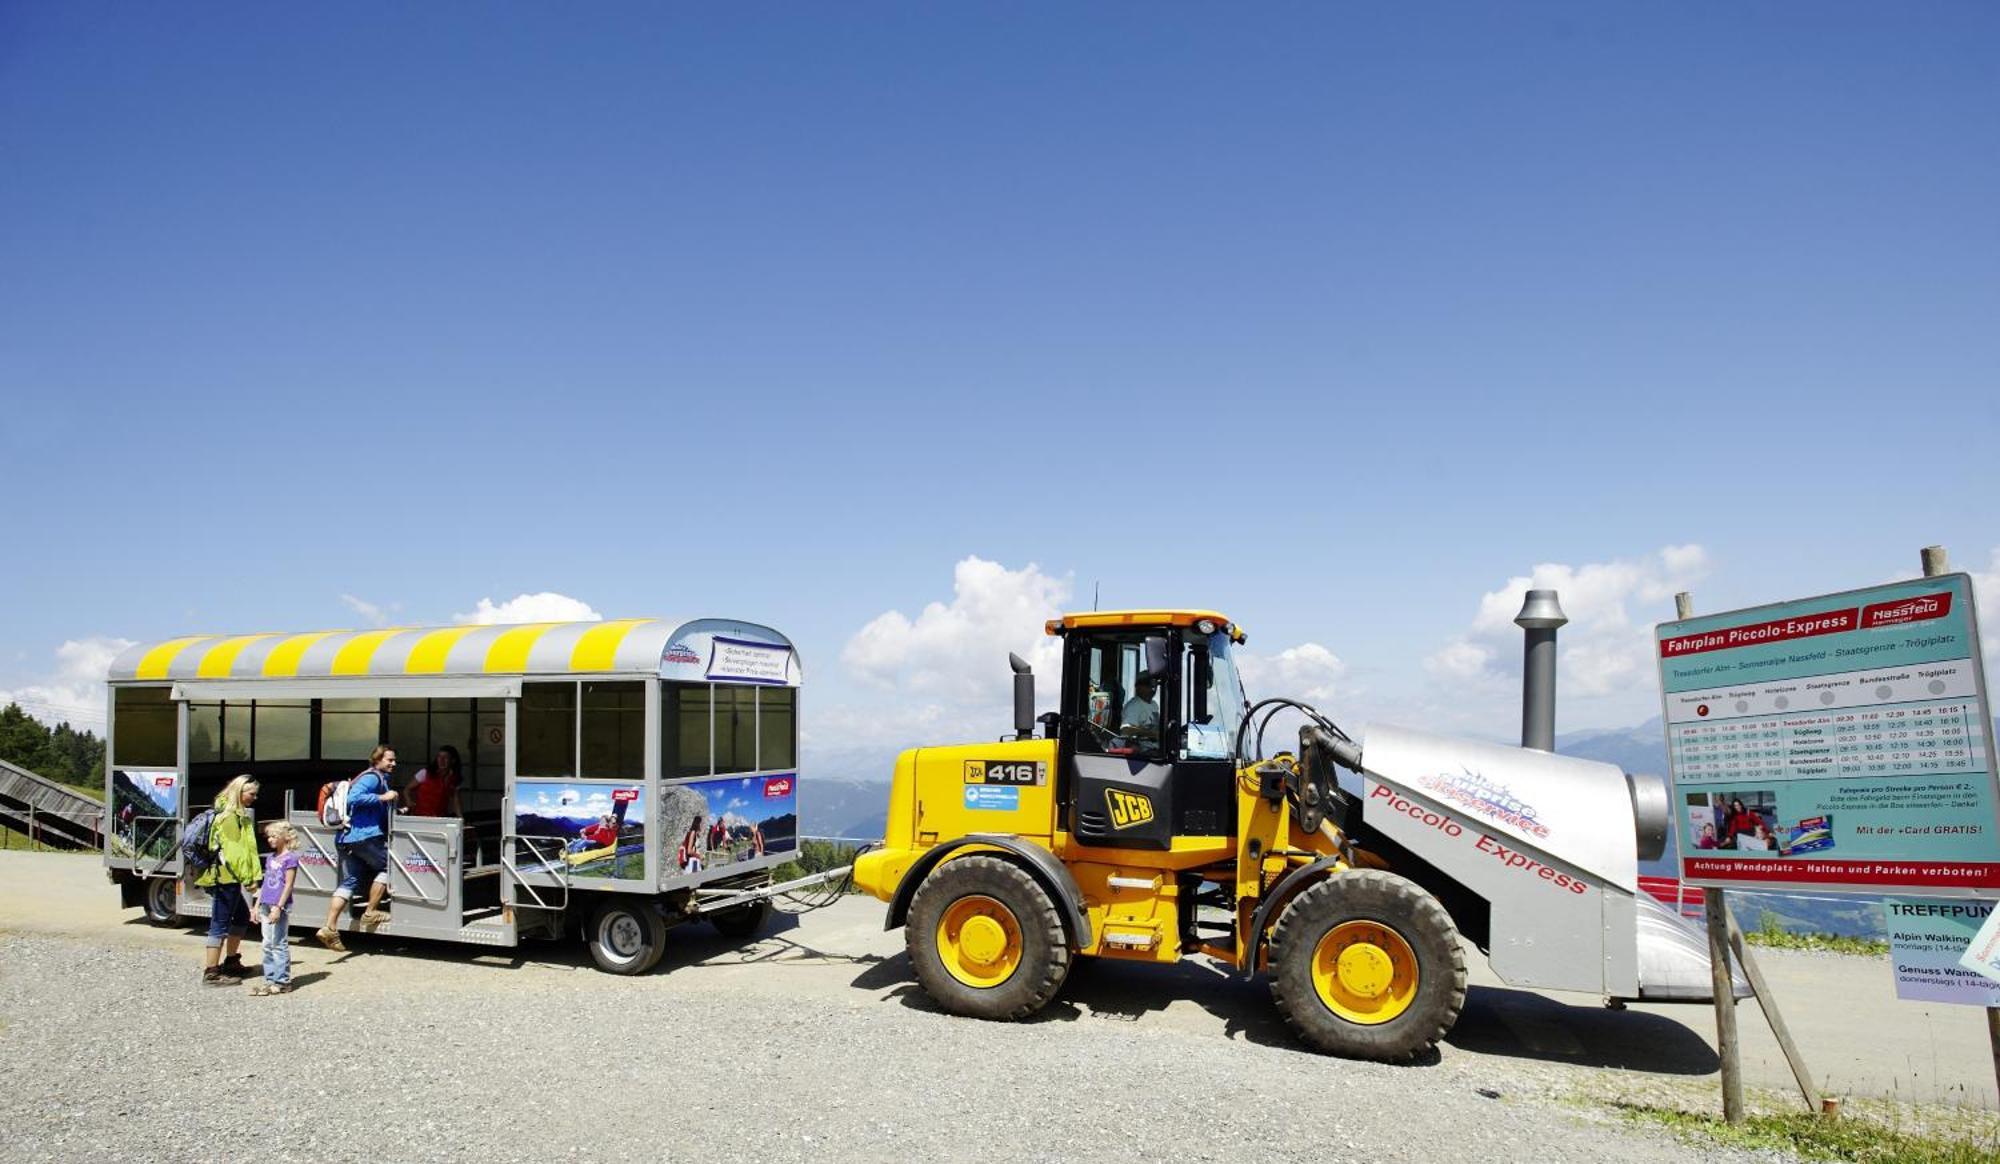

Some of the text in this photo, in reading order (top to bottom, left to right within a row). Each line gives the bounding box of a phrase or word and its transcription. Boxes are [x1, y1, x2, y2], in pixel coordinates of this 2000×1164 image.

[1873, 600, 1938, 620] Nassfeld
[1668, 634, 1724, 652] Fahrplan
[1729, 616, 1848, 643] Piccolo-Express
[1789, 650, 1826, 662] Nassfeld
[1836, 642, 1896, 658] Staatsgrenze
[1806, 680, 1850, 690] Staatsgrenze
[1860, 673, 1910, 684] Bundesstraße
[988, 765, 1032, 781] 416
[1114, 792, 1151, 825] JCB
[1857, 826, 1872, 834] Mit
[1877, 826, 1893, 834] der
[1934, 825, 1983, 834] GRATIS!
[1371, 784, 1588, 894] Piccolo Express
[1694, 862, 1732, 871] Achtung
[1734, 862, 1793, 873] Wendeplatz
[1807, 864, 1844, 874] Halten
[1848, 865, 1871, 874] und
[1875, 866, 1917, 875] Parken
[1922, 867, 1988, 877] verboten!
[1894, 932, 1970, 945] Alpin Walking
[1894, 943, 1933, 952] montags
[1899, 964, 1941, 976] Genuss
[1900, 975, 1955, 987] donnerstags
